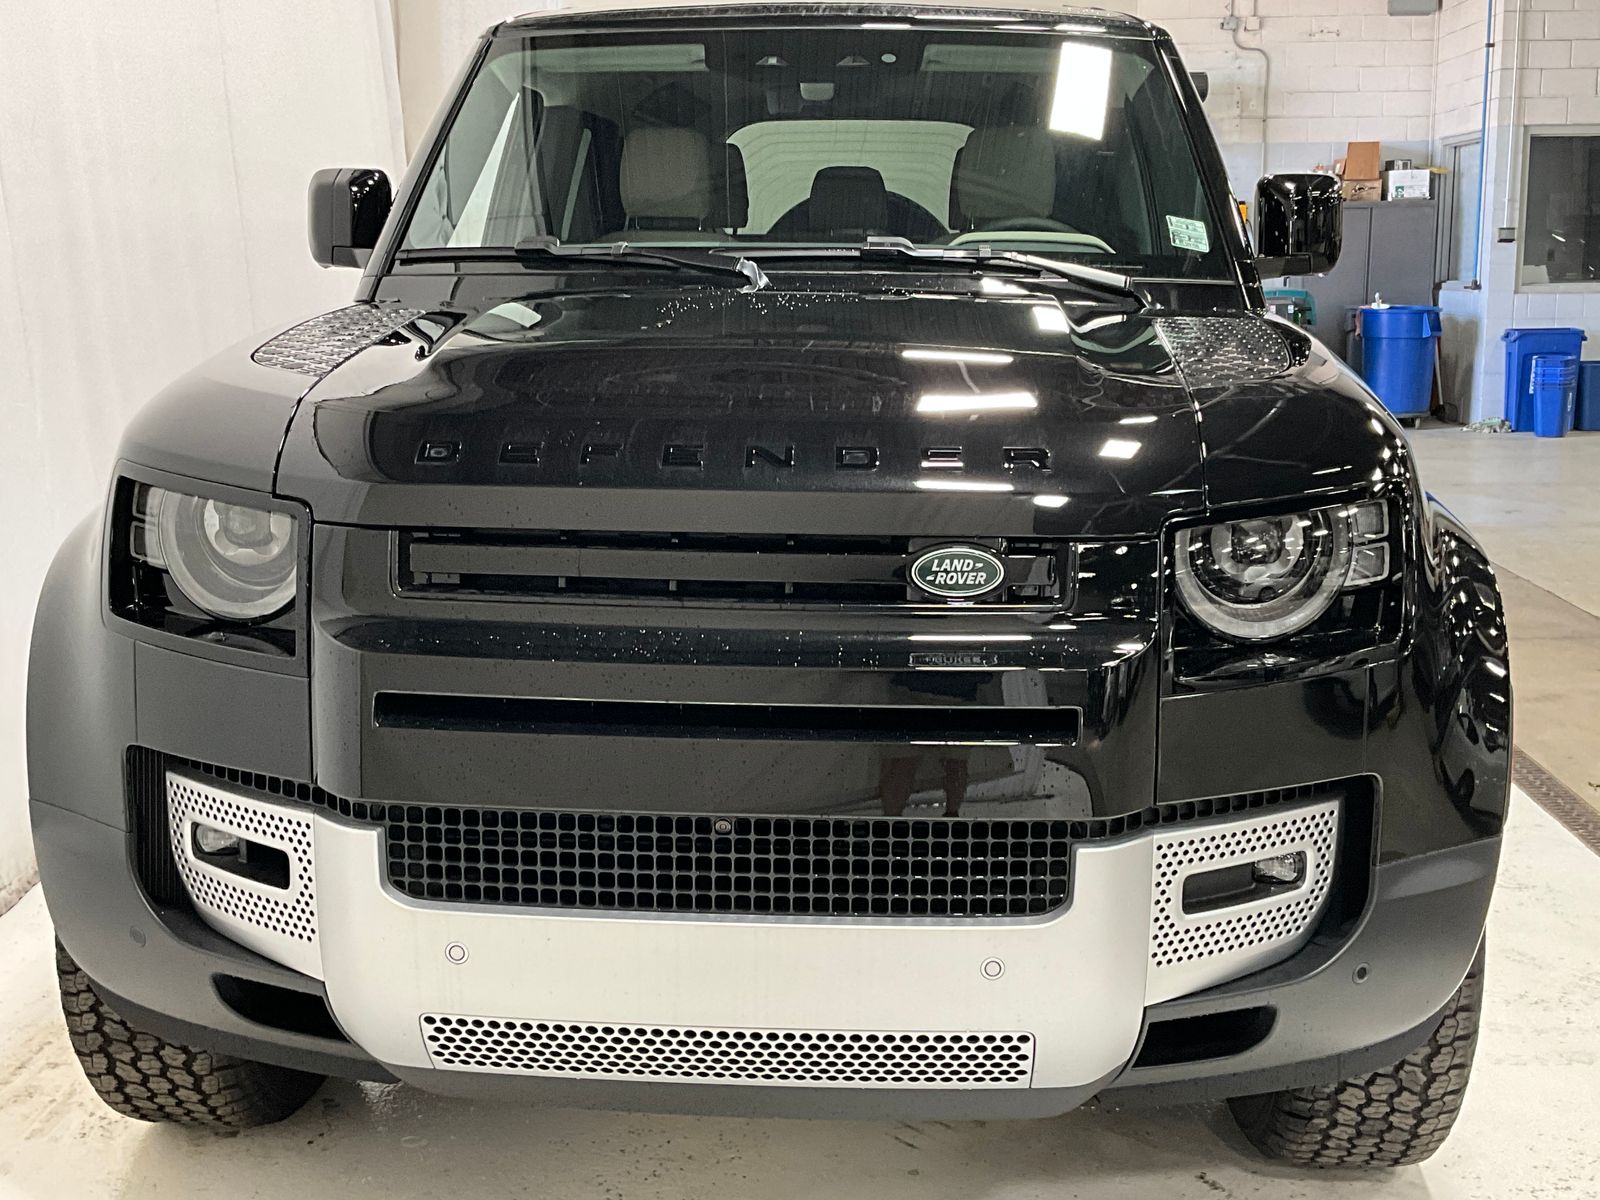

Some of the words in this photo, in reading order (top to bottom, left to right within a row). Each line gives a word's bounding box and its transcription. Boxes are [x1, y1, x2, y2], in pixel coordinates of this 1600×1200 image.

[415, 440, 1051, 471] DEFENDER
[931, 558, 974, 572] LAND
[935, 572, 987, 585] ROVER
